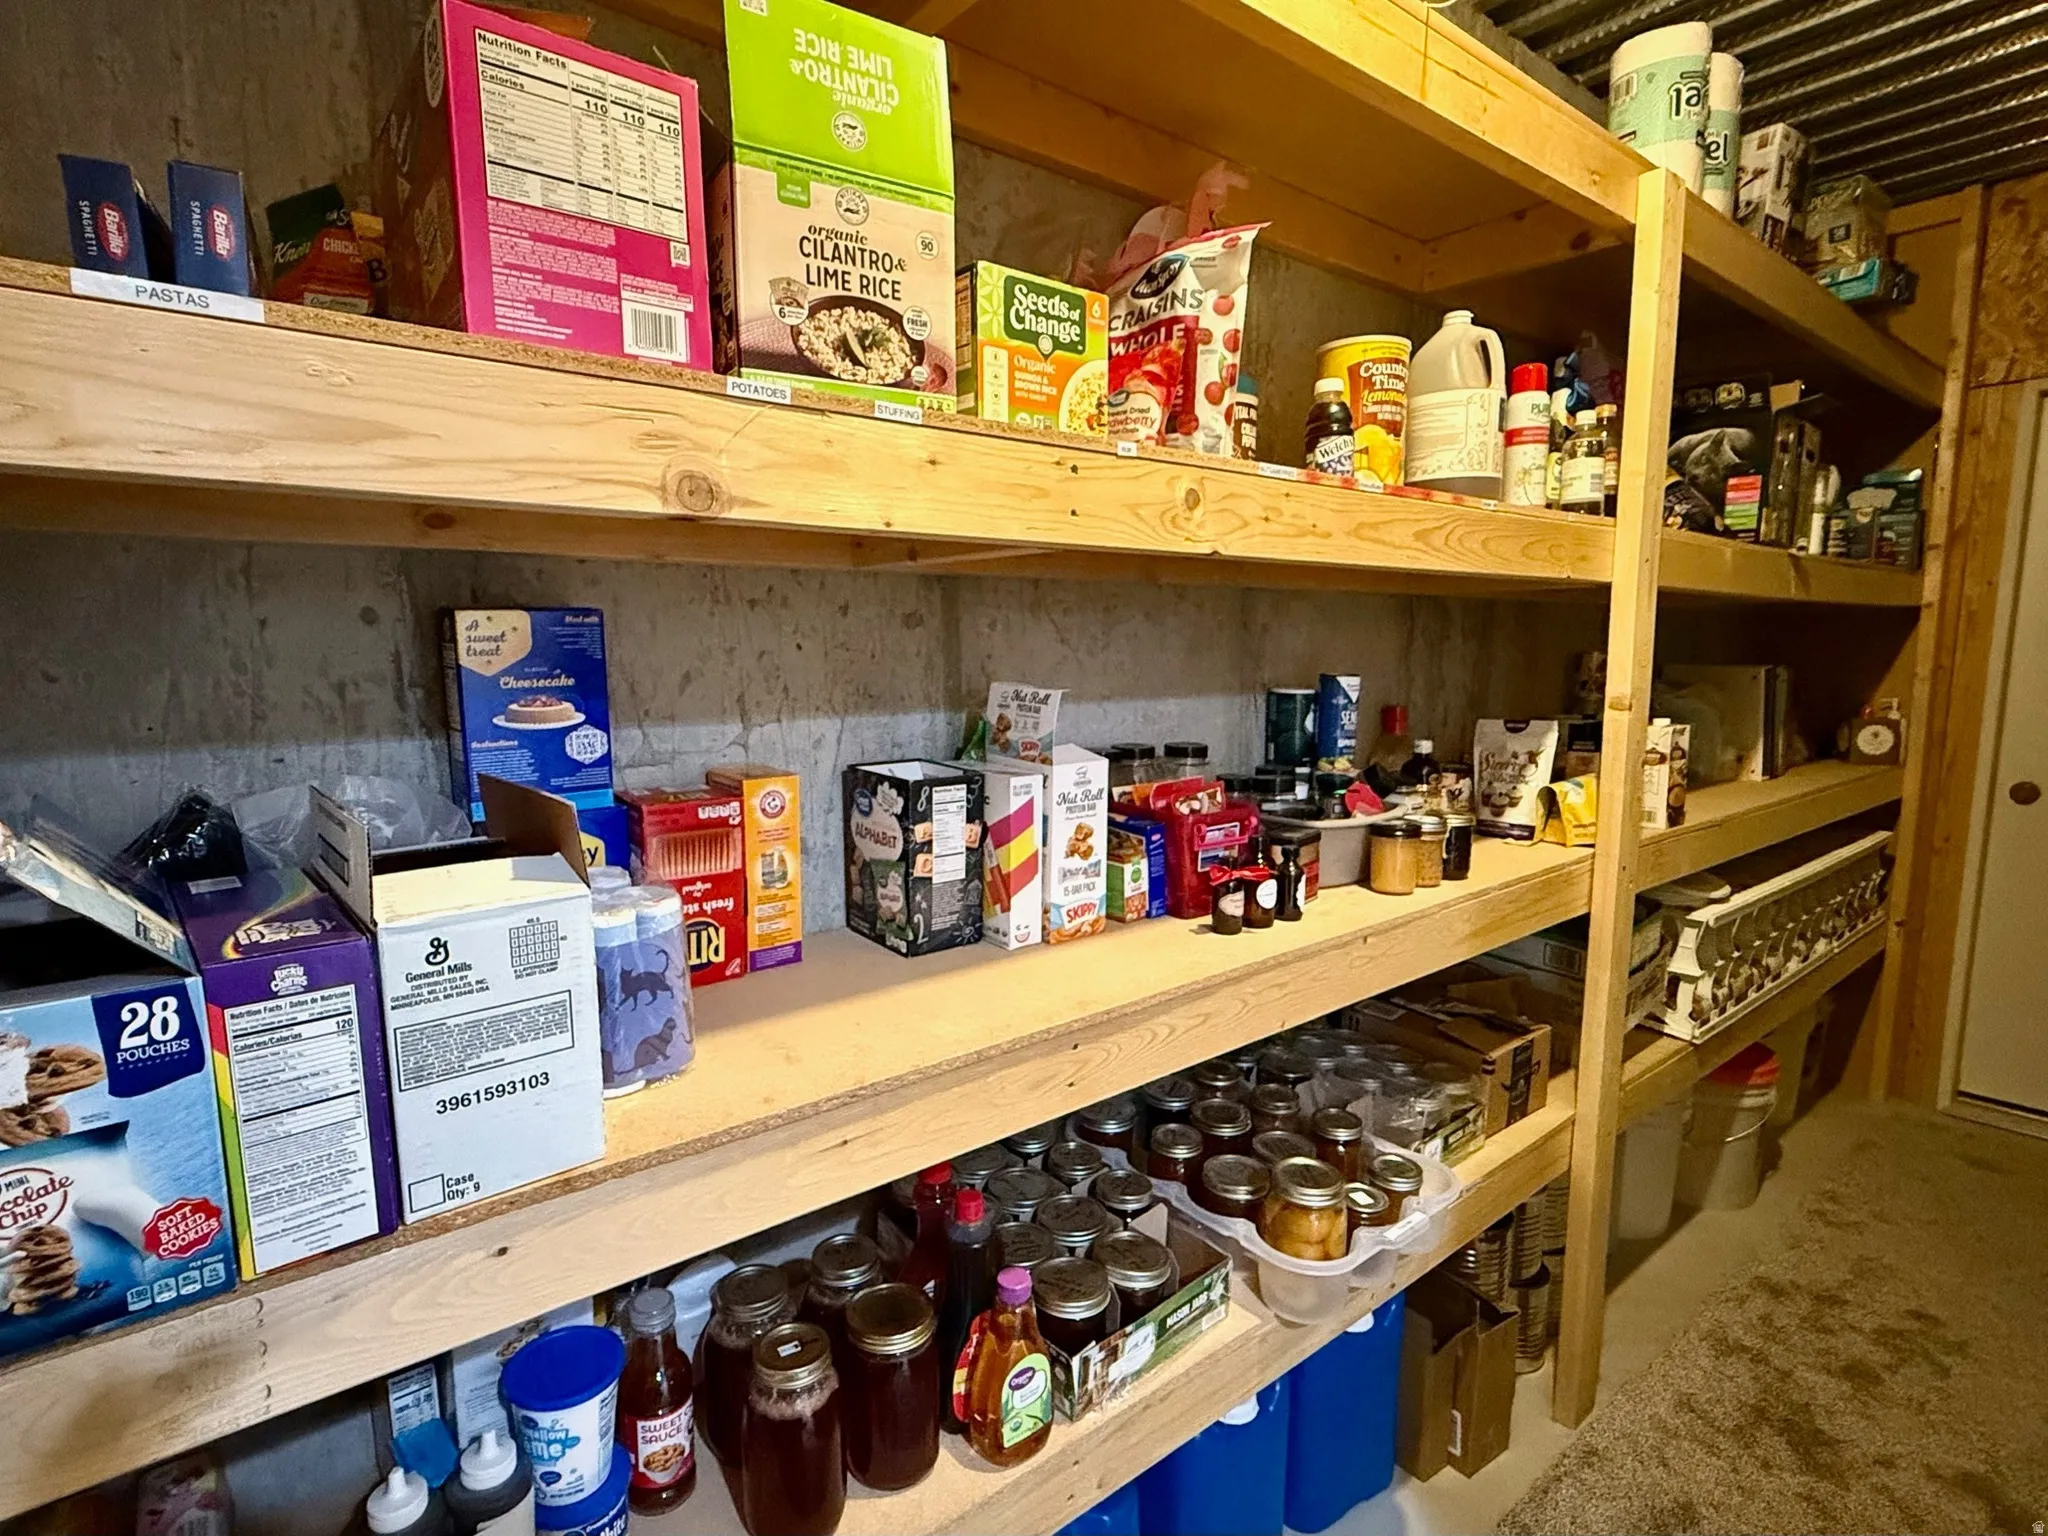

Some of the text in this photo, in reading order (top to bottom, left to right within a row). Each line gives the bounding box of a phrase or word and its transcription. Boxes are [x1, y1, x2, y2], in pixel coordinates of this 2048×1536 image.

[477, 32, 567, 70] Nutrition Facts
[793, 28, 893, 80] LIME RICE
[481, 70, 680, 137] Calories 110 110 110
[79, 200, 97, 256] SPAGHETTI
[101, 208, 122, 260] Barilla
[190, 200, 204, 256] SPAGHETTI
[212, 208, 228, 258] Barilla
[808, 224, 868, 247] organic
[799, 236, 893, 274] CILANTRO
[920, 240, 934, 252] 90
[806, 263, 902, 301] LIME RICE
[135, 284, 210, 309] PASTAS
[1014, 284, 1070, 319] Seeds
[778, 306, 787, 319] 6
[1091, 300, 1101, 318] 6
[1109, 288, 1205, 332] CRAISINS
[906, 317, 928, 329] FRESH
[1009, 304, 1081, 344] Change
[1013, 354, 1057, 375] Organic
[731, 381, 787, 400] POTATOES
[1372, 375, 1406, 392] Time
[1362, 388, 1406, 407] Lemona
[877, 403, 920, 420] STUFFING
[1108, 415, 1158, 428] awberry
[465, 619, 479, 632] A
[465, 630, 507, 644] sweet
[465, 644, 503, 657] treat
[500, 673, 576, 689] Cheesecake
[1010, 689, 1052, 706] Nut Roll
[1056, 787, 1105, 807] Nut Roll
[855, 821, 898, 850] ALPHABET
[1065, 902, 1098, 924] SKIPPY
[688, 926, 726, 966] RIT
[270, 975, 309, 992] Charms
[405, 962, 473, 983] General Mills
[389, 991, 425, 1003] GENERAL
[427, 985, 448, 996] MILLS
[410, 976, 458, 992] DISTRIBUTED
[475, 985, 490, 993] USA
[119, 996, 181, 1050] 28
[230, 1008, 263, 1020] Nutrition
[263, 1004, 283, 1014] Facts
[335, 1018, 354, 1030] 120
[116, 1038, 191, 1064] POUCHES
[436, 1071, 551, 1115] 3961593103
[4, 1175, 31, 1192] MINI
[446, 1172, 475, 1189] Case
[446, 1181, 481, 1201] Qty: 9
[0, 1176, 75, 1213] colate
[0, 1202, 49, 1230] Chip
[157, 1205, 194, 1231] SOFT
[159, 1212, 206, 1244] BAKED
[159, 1218, 220, 1257] COOKIES
[640, 1412, 683, 1435] SWEET
[640, 1423, 683, 1445] SAUCE
